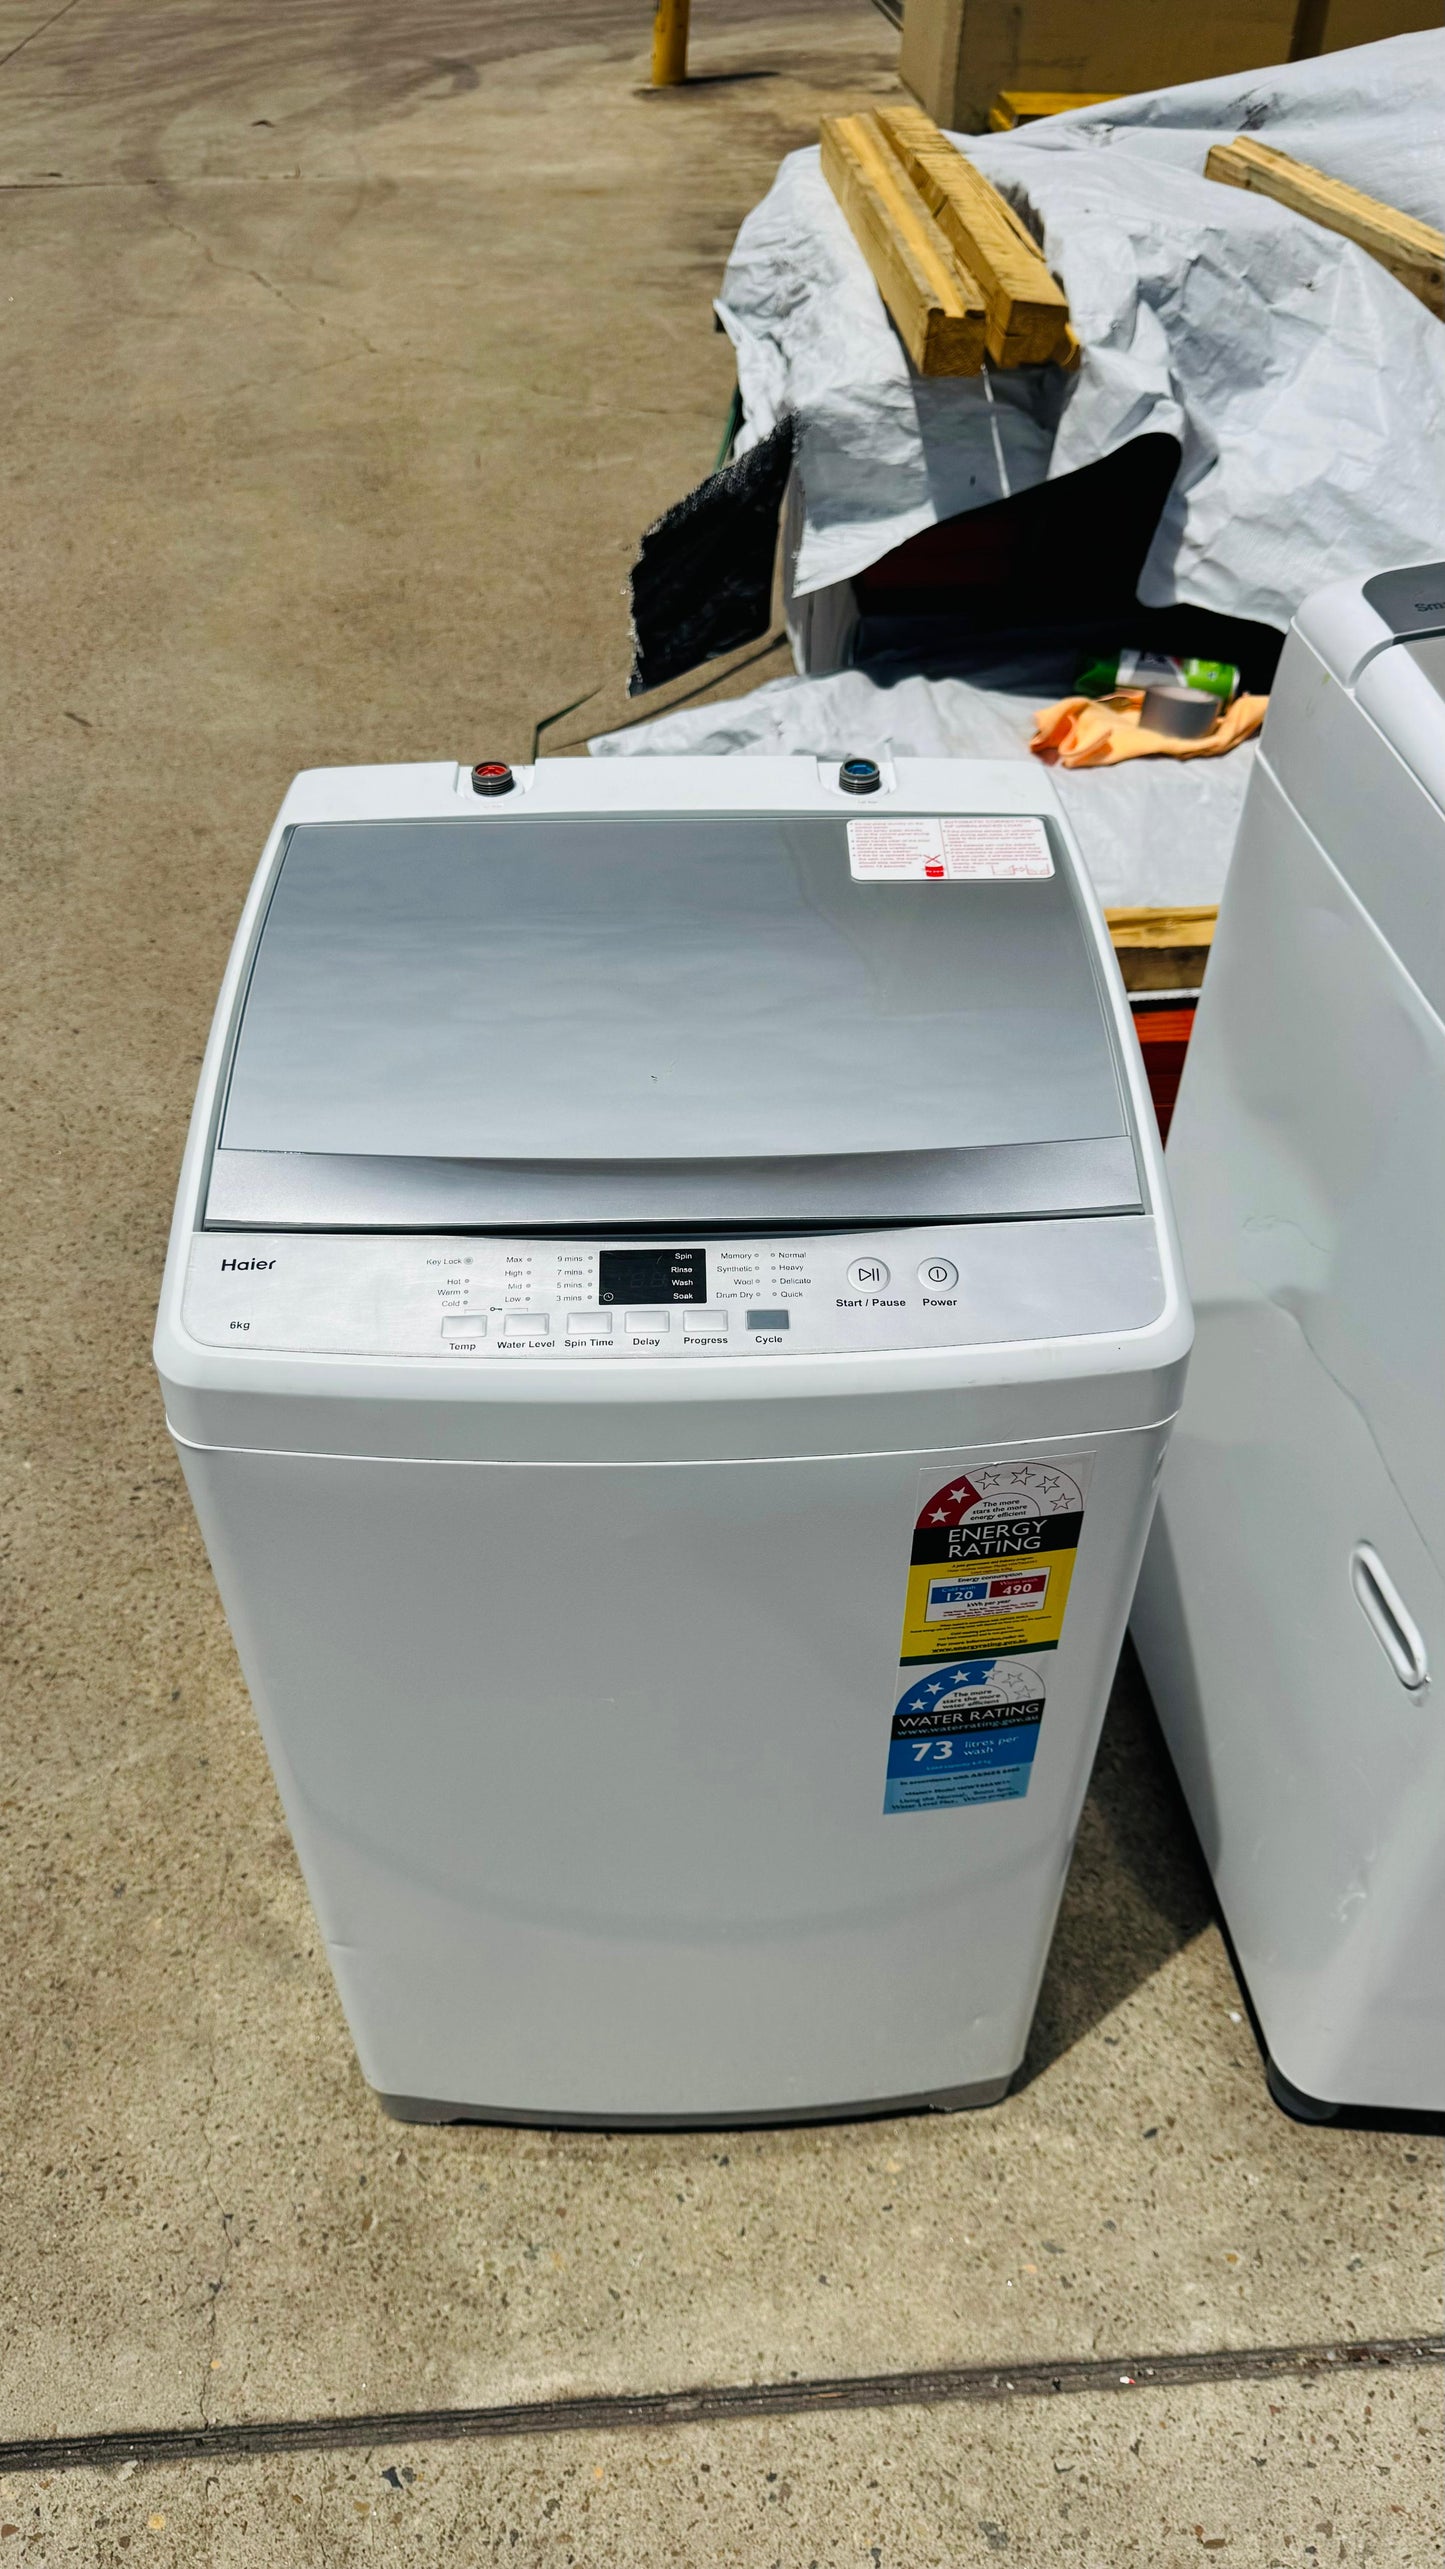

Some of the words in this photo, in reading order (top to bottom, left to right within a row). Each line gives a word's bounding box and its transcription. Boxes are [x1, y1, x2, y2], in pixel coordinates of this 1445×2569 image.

[721, 1252, 752, 1260] Memory
[221, 1257, 276, 1271] Haier
[426, 1258, 441, 1266] Key
[716, 1265, 752, 1273] Synthetic
[779, 1264, 804, 1272] Heavy
[780, 1290, 803, 1298] Quick
[836, 1298, 864, 1306] Start
[872, 1298, 906, 1306] Pause
[923, 1298, 958, 1306] Power
[229, 1321, 250, 1331] 6kg
[497, 1340, 525, 1348] Water
[527, 1340, 555, 1348] Level
[564, 1339, 587, 1348] Spin
[589, 1338, 614, 1346] Time
[632, 1337, 660, 1346] Delay
[684, 1336, 728, 1345] Progress
[755, 1335, 782, 1344] Cycle
[449, 1342, 476, 1351] Temp
[949, 1520, 1047, 1542] ENERGY
[949, 1536, 1041, 1558] RATING
[1002, 1584, 1032, 1594] 490
[947, 1591, 973, 1601] 120
[900, 1714, 964, 1727] WATER
[970, 1704, 1039, 1720] RATING
[998, 1736, 1019, 1746] per
[912, 1741, 952, 1762] 73
